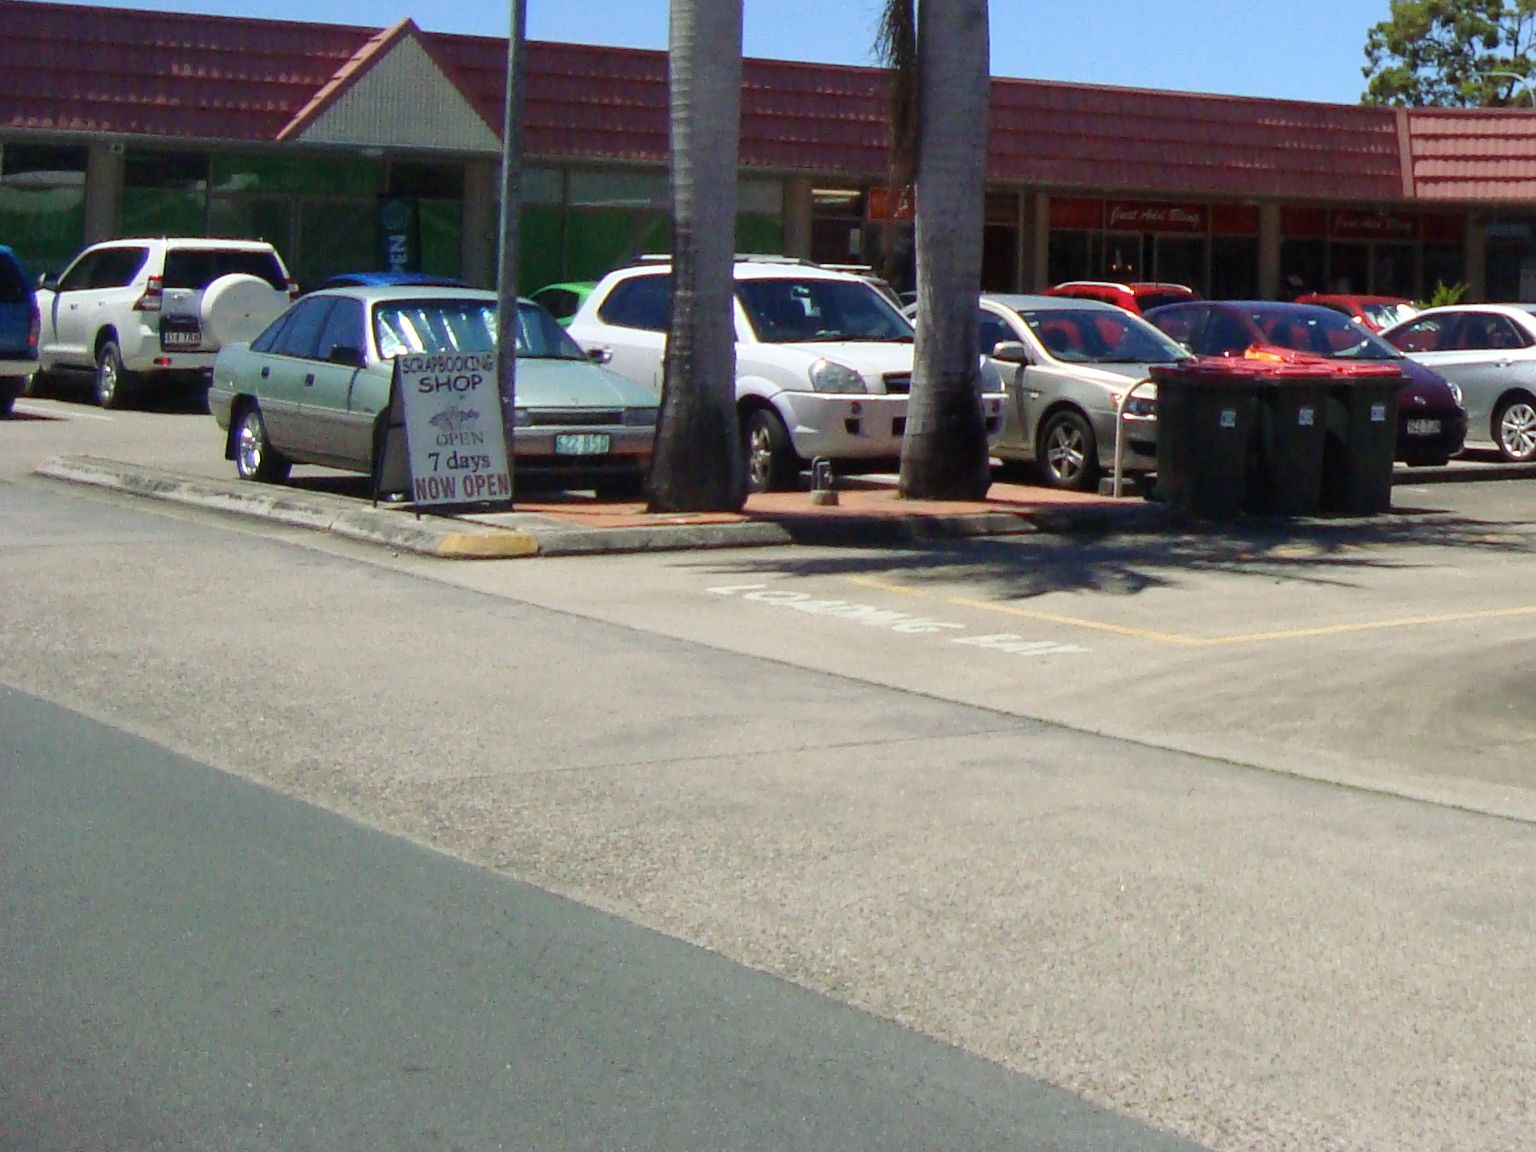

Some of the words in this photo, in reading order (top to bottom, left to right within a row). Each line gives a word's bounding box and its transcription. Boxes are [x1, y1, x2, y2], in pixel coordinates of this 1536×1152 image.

[418, 374, 483, 393] SHOP
[436, 431, 484, 447] OPEN
[428, 452, 440, 472] 7
[446, 451, 491, 472] days
[415, 476, 456, 500] NOW
[463, 473, 510, 498] OPEN
